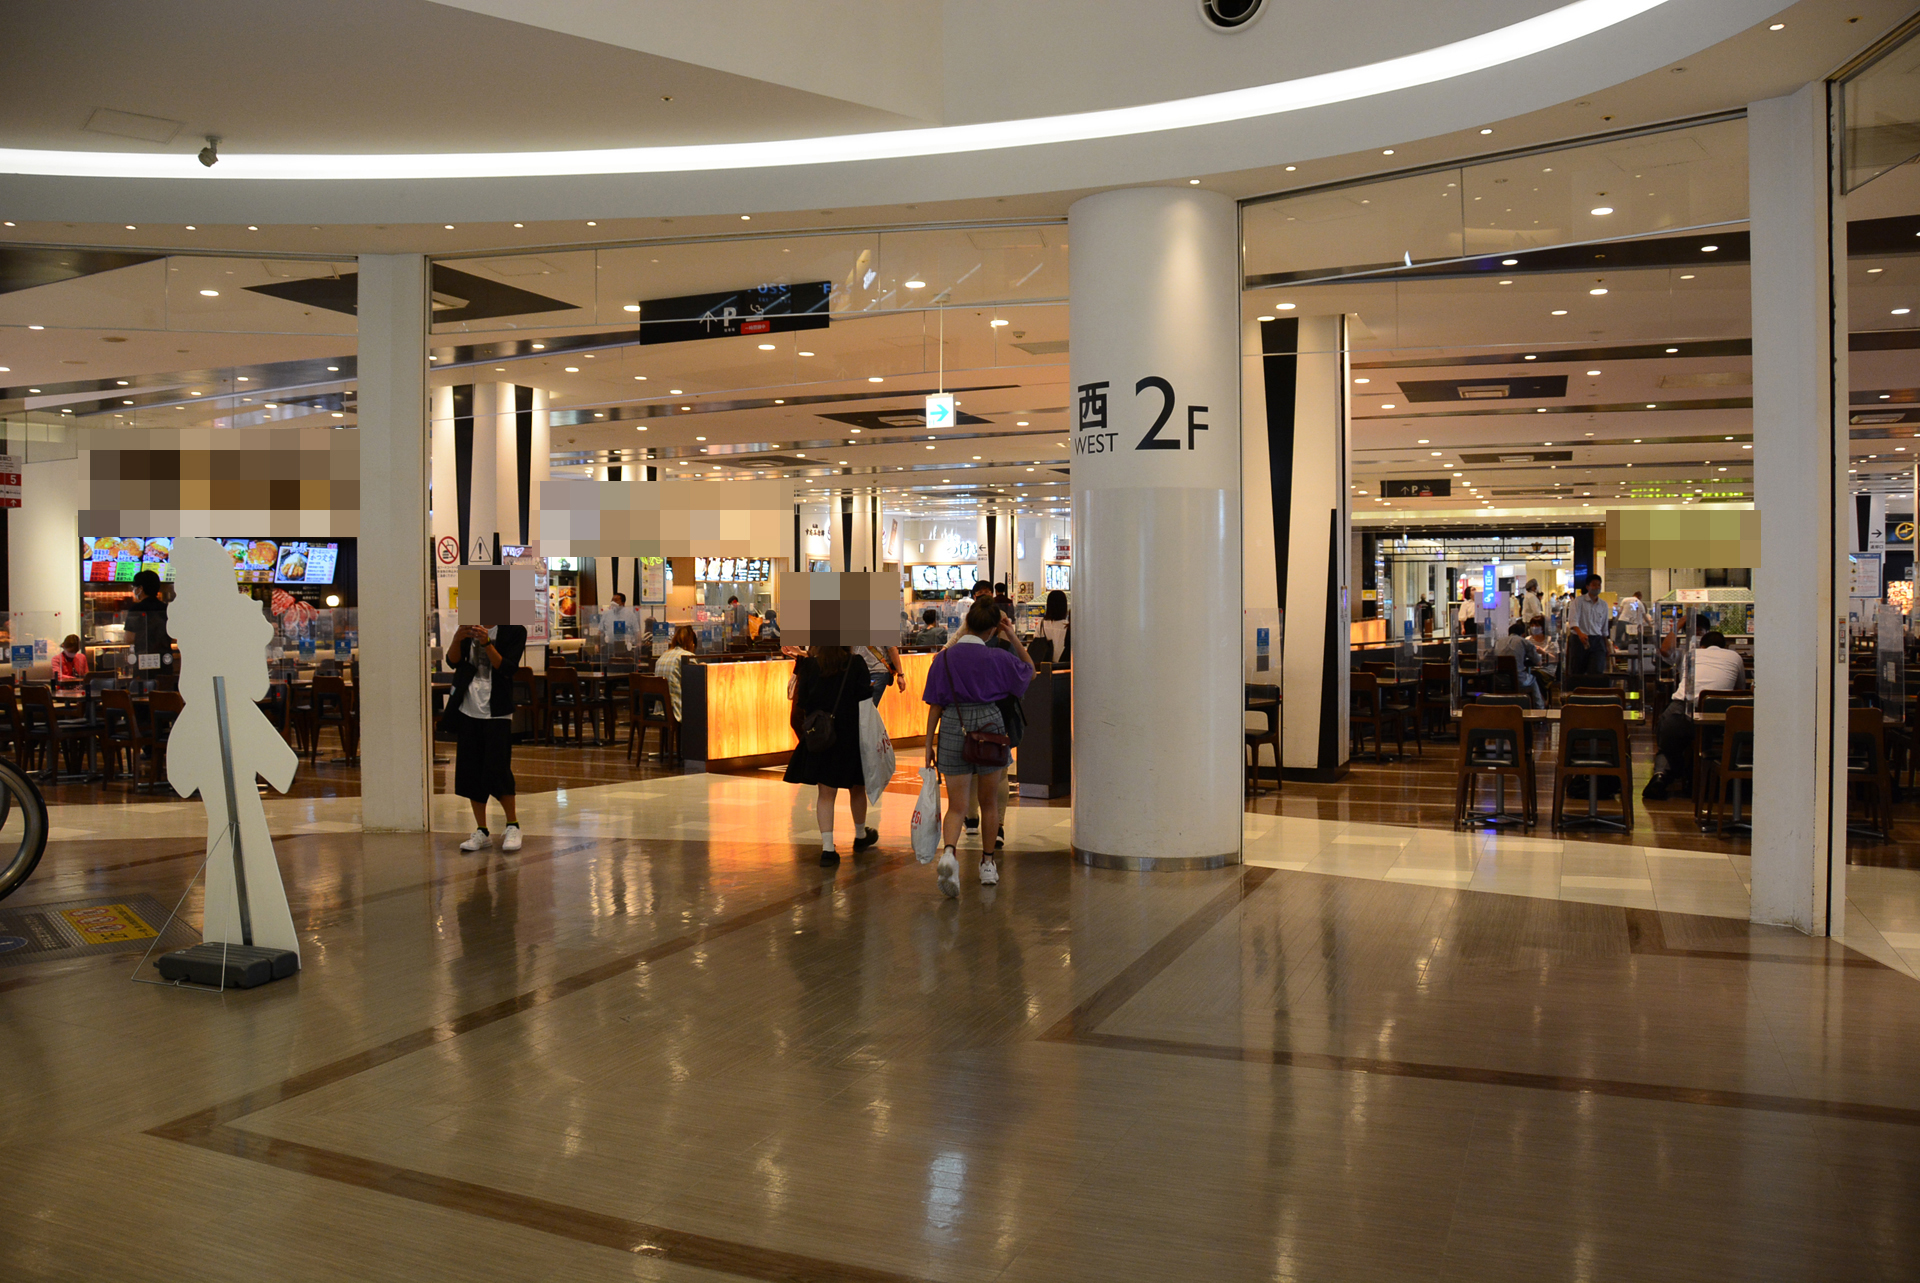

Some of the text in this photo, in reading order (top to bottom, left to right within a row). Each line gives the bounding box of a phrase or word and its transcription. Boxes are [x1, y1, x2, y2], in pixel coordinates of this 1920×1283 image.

[723, 306, 737, 327] P
[1077, 380, 1110, 432] 西
[1134, 375, 1209, 451] 2F
[1074, 432, 1119, 456] WEST
[10, 474, 17, 485] 5
